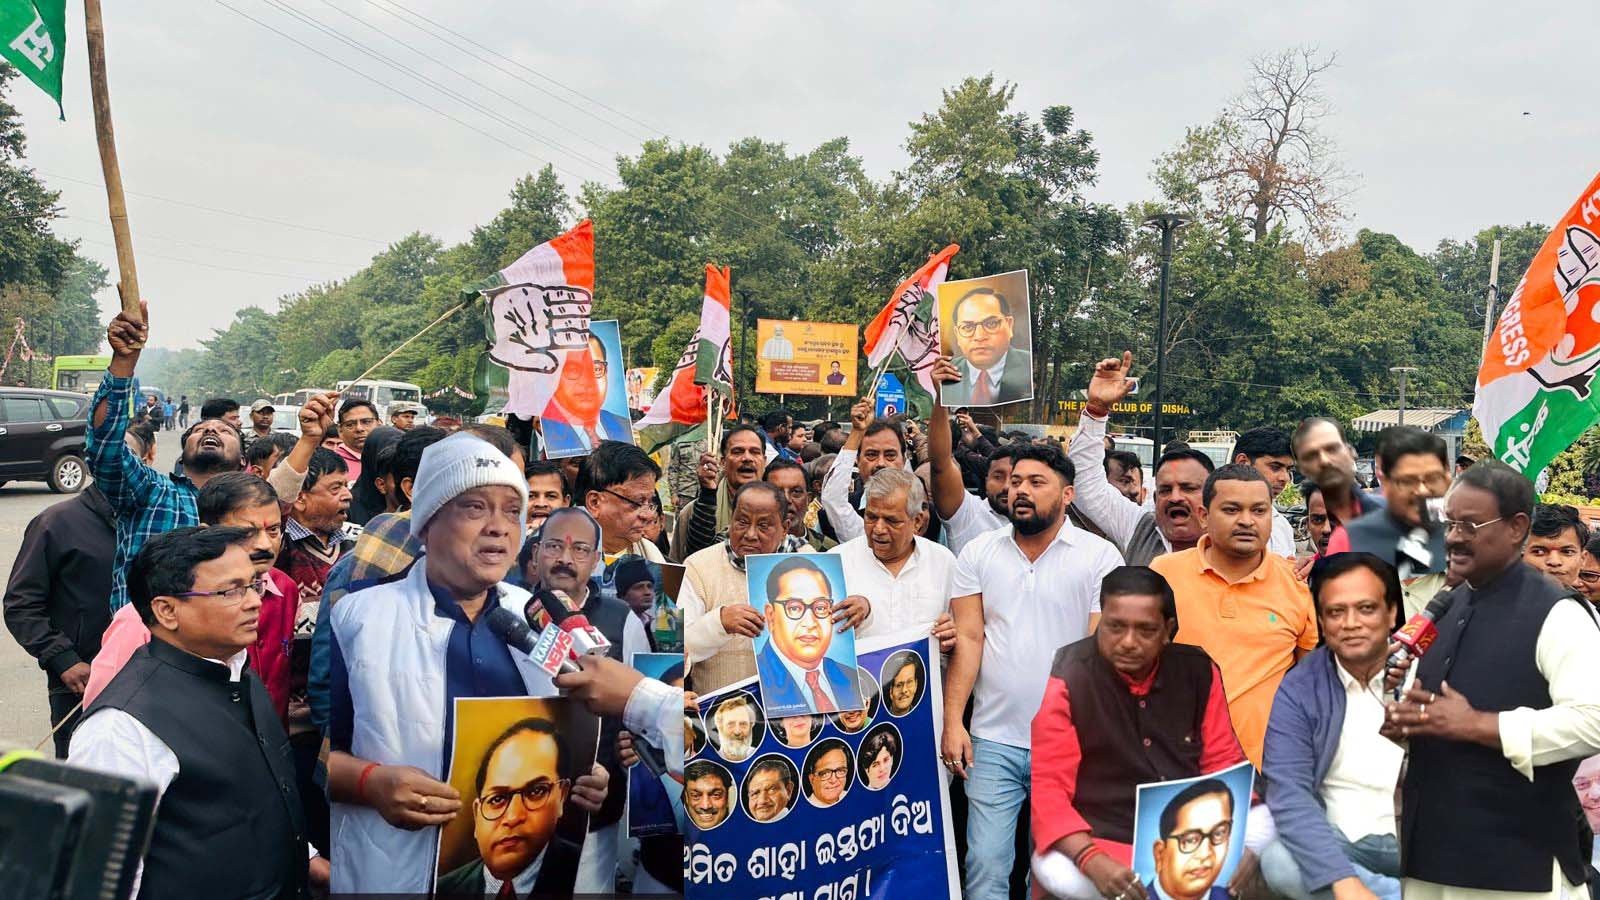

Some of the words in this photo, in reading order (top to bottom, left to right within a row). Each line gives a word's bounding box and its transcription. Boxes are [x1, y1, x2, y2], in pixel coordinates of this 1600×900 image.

[1057, 400, 1077, 410] THE
[1112, 402, 1137, 412] CLUB
[1139, 403, 1153, 413] OF
[1161, 404, 1191, 414] DISHA
[535, 626, 560, 662] KANAK
[543, 631, 573, 671] NEWS
[747, 840, 806, 881] ଶାହା
[891, 793, 933, 836] ଦିଅ
